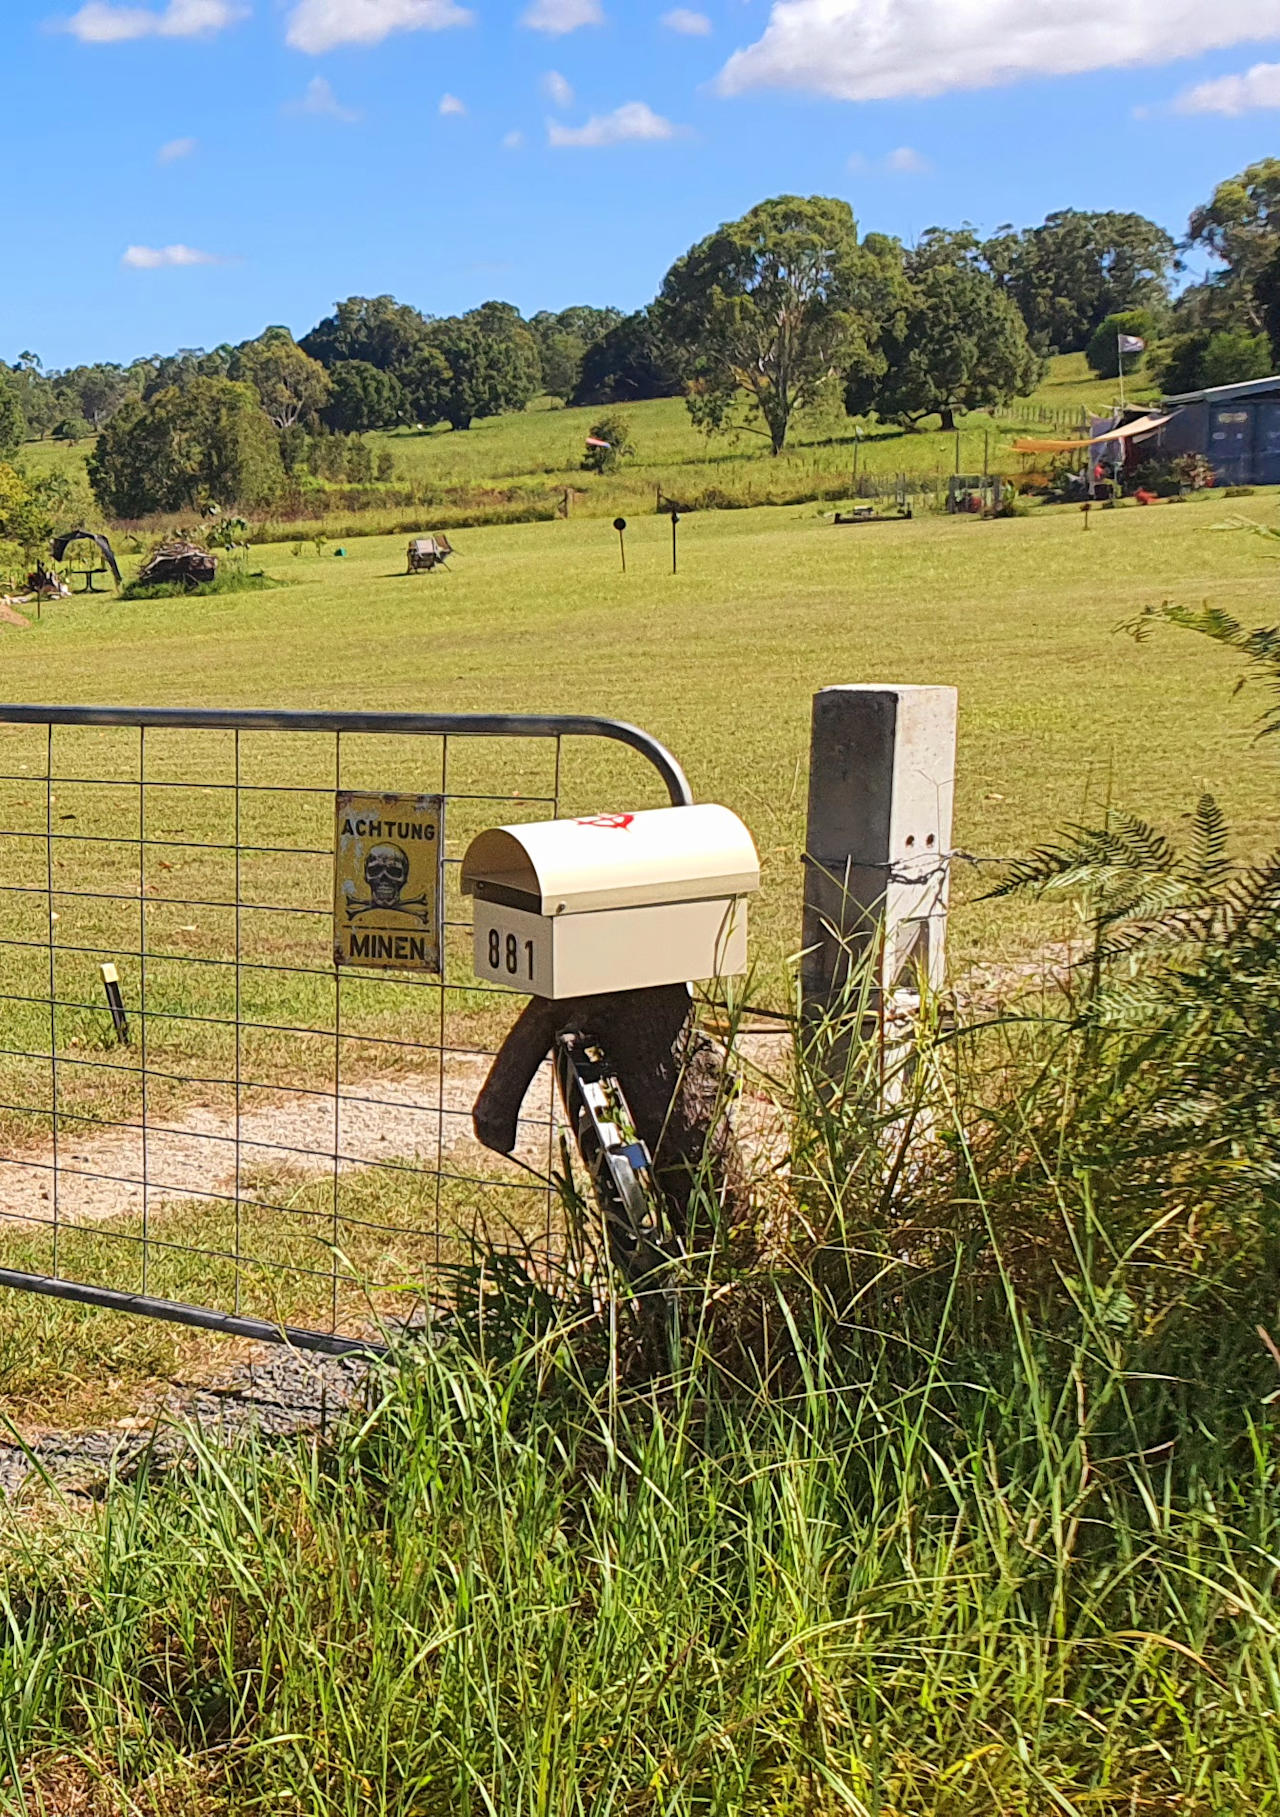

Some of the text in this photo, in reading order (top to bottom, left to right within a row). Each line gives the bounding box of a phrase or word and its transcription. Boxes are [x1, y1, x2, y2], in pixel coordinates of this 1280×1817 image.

[341, 818, 436, 841] ACHTUNG
[349, 933, 426, 961] MINEN
[488, 928, 534, 981] 881
